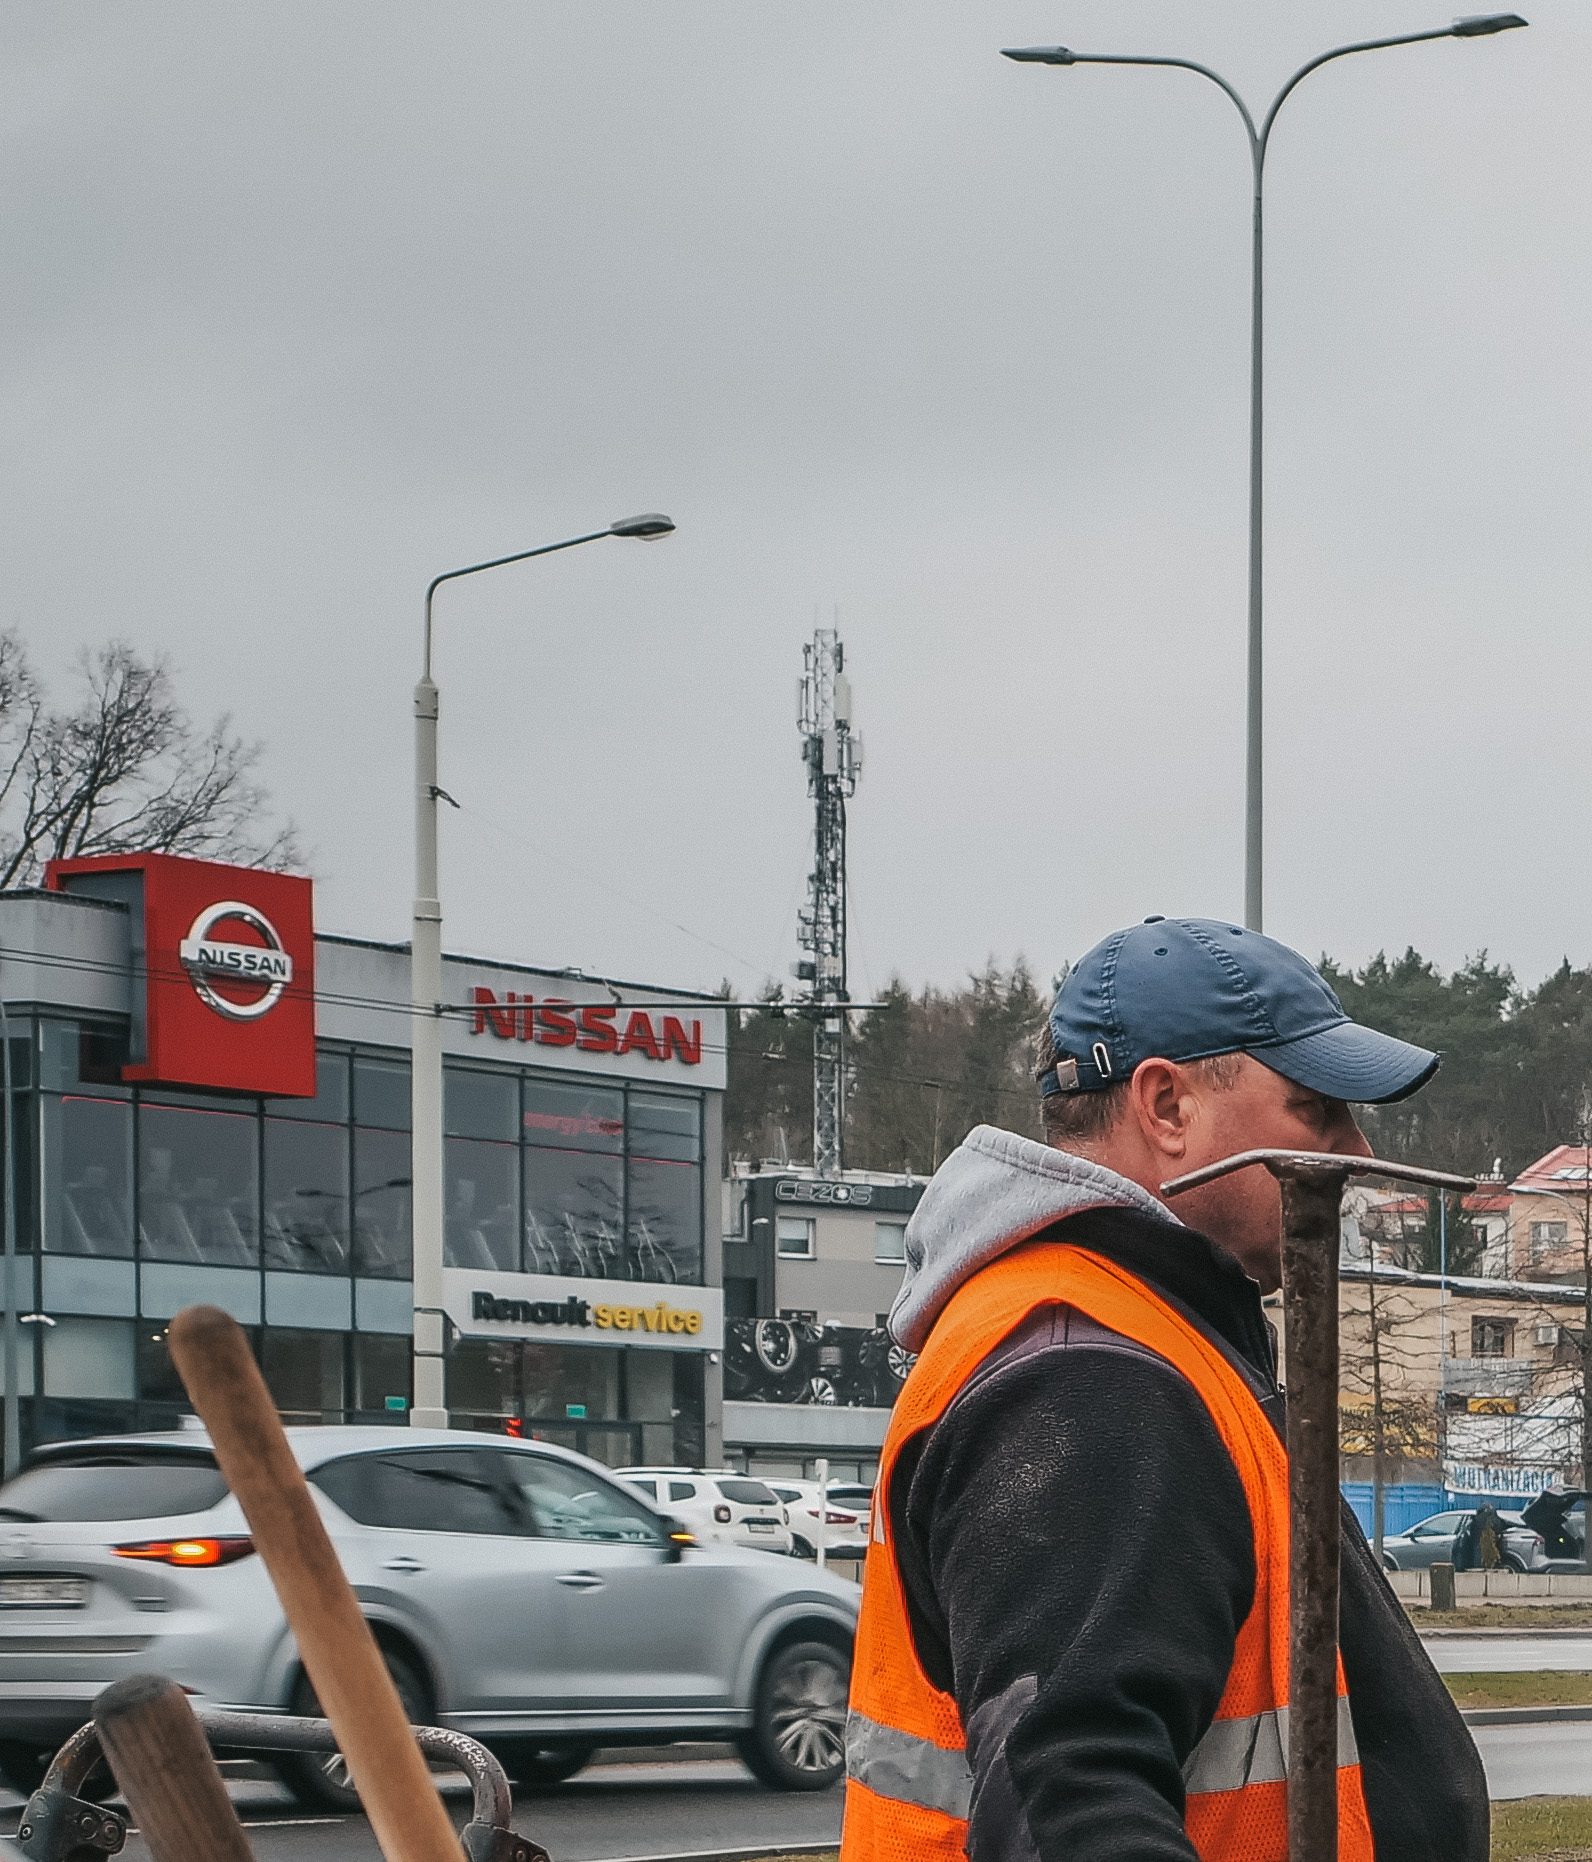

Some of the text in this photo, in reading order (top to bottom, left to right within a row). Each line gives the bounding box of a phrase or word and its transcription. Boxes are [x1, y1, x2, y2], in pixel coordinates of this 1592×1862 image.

[198, 948, 286, 976] NISSAN
[471, 986, 702, 1064] NISSAN
[471, 1290, 702, 1335] Renault service
